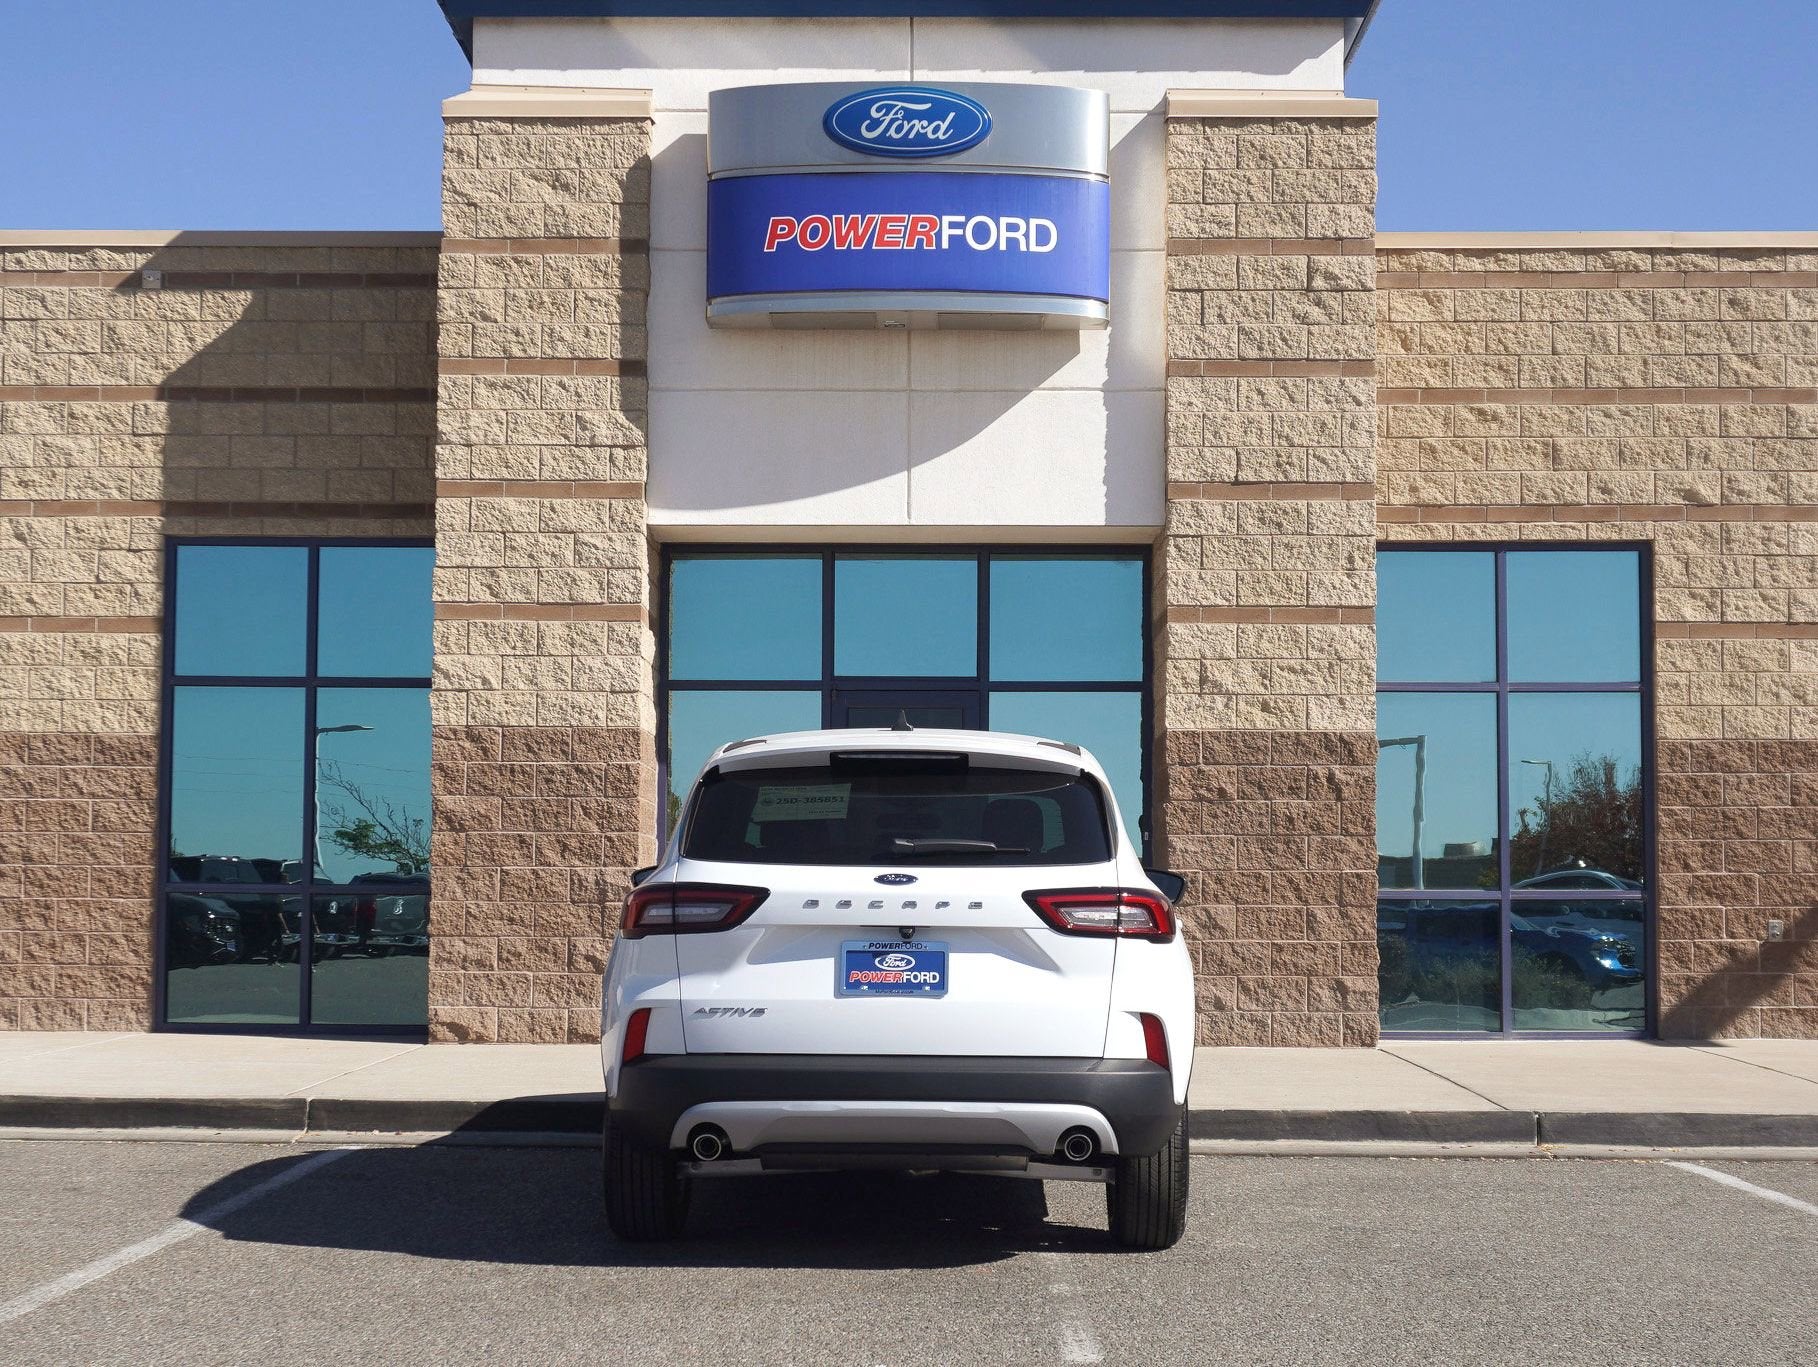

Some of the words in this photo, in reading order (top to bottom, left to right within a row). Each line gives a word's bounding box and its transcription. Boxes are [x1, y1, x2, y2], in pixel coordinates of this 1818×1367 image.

[859, 99, 956, 141] Ford
[764, 213, 1059, 253] POWERFORD
[802, 900, 983, 910] ESCAPE
[882, 954, 907, 967] Ford
[849, 970, 940, 983] POWERFORD
[690, 1007, 768, 1019] ACTIVE
